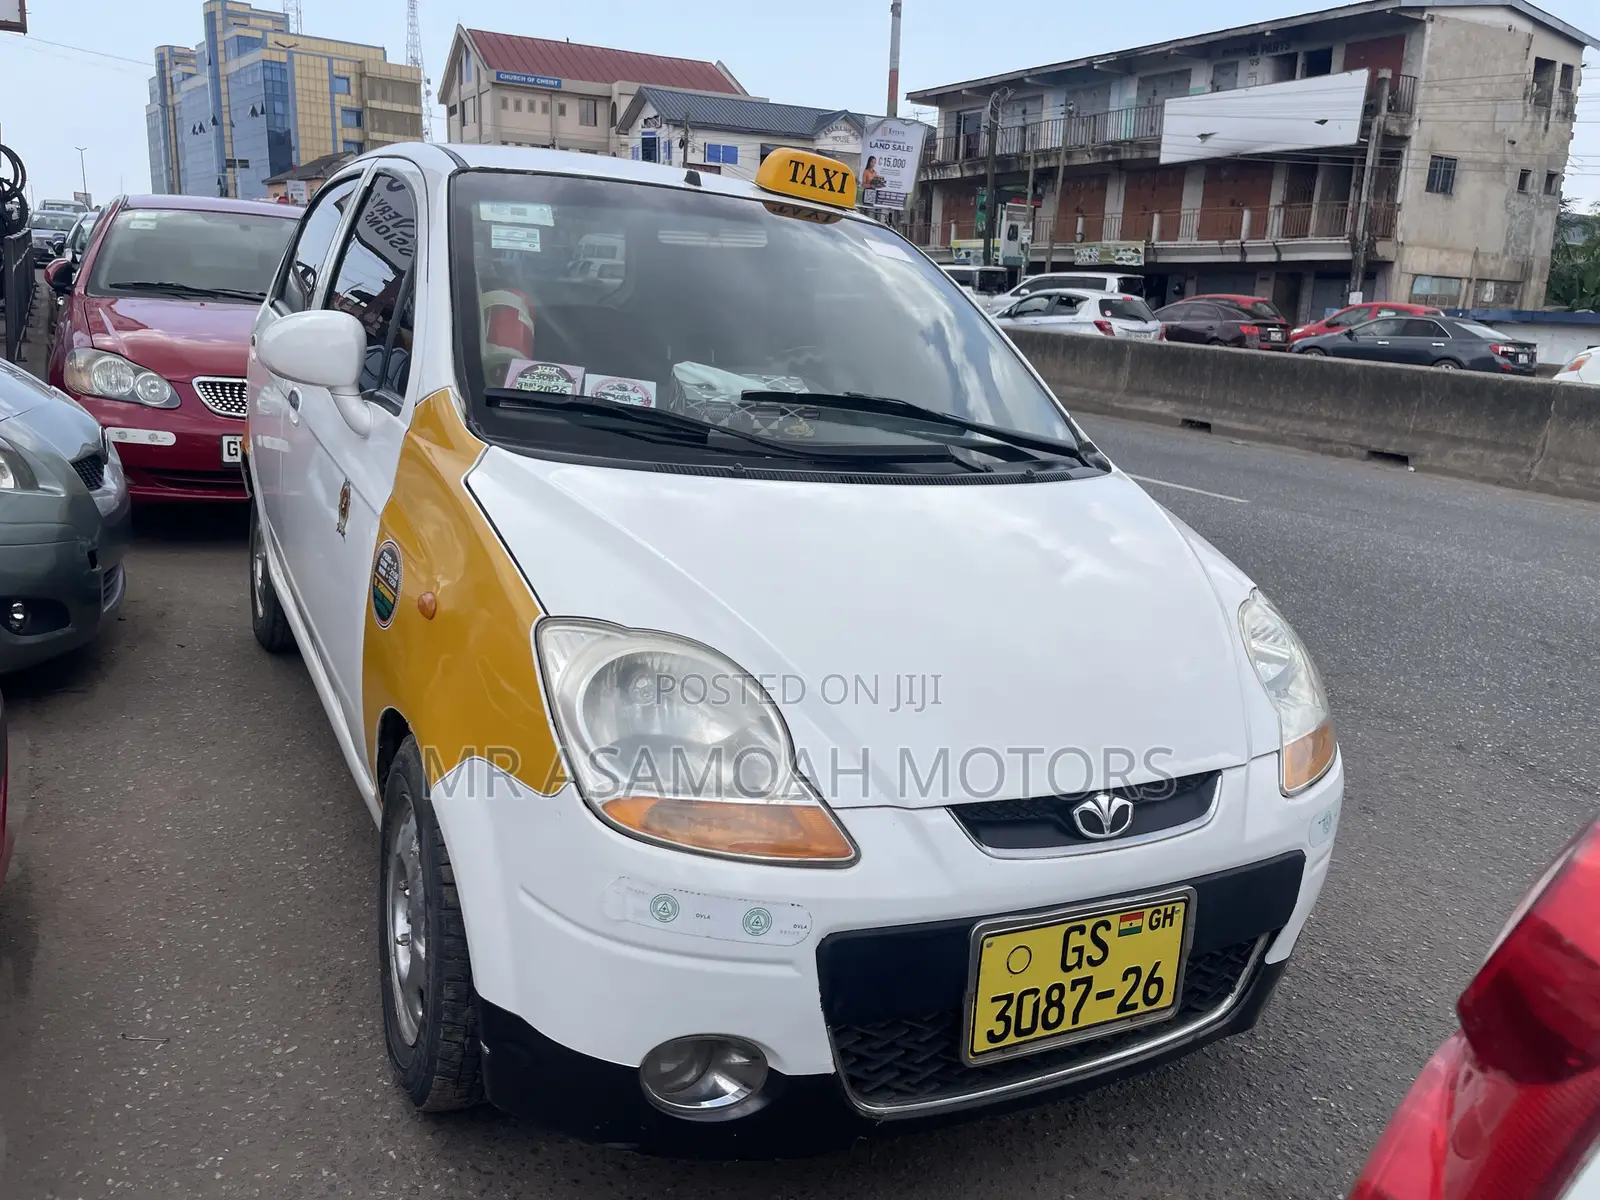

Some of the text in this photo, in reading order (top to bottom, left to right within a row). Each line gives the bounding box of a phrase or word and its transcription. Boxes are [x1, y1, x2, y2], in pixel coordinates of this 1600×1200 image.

[499, 73, 526, 82] CHURCH
[536, 78, 558, 86] CHRIST
[832, 135, 850, 144] HOUSE
[869, 141, 890, 150] LAND
[891, 143, 914, 152] SALE!
[788, 159, 850, 194] TAXI
[1060, 906, 1176, 973] GS GH
[986, 961, 1164, 1044] 3087-26
